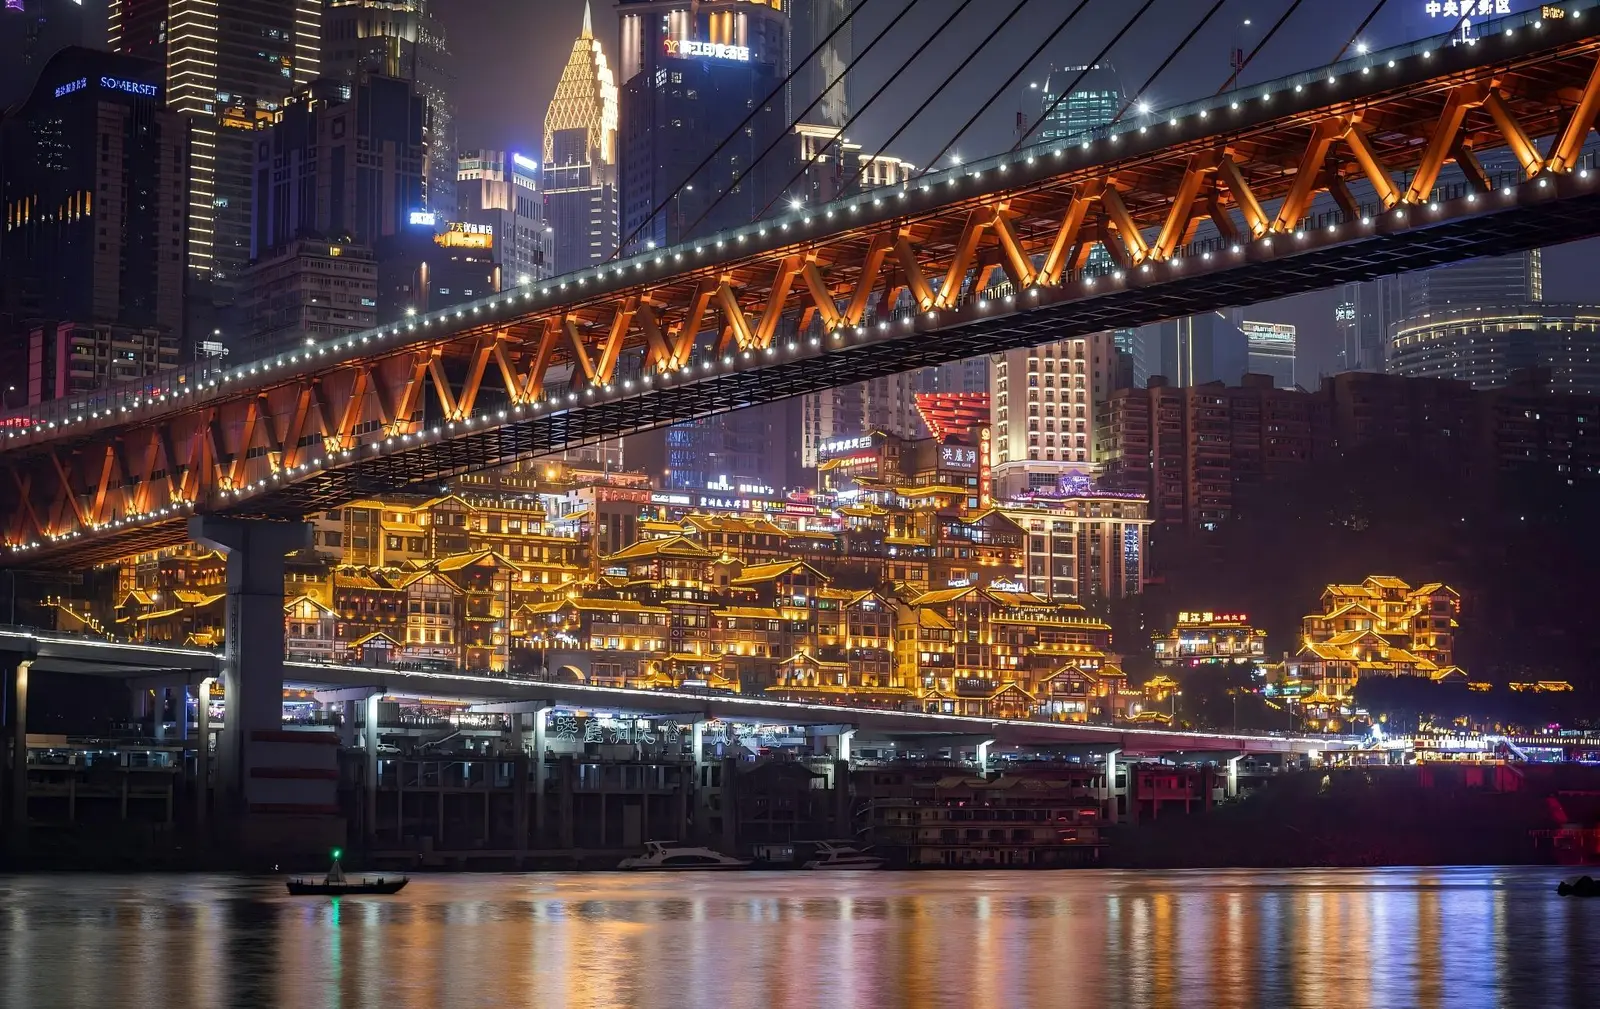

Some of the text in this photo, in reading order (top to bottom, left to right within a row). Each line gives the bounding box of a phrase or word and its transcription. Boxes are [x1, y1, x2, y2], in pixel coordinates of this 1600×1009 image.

[100, 76, 157, 96] SOMERSET
[942, 448, 976, 463] 洪崖洞
